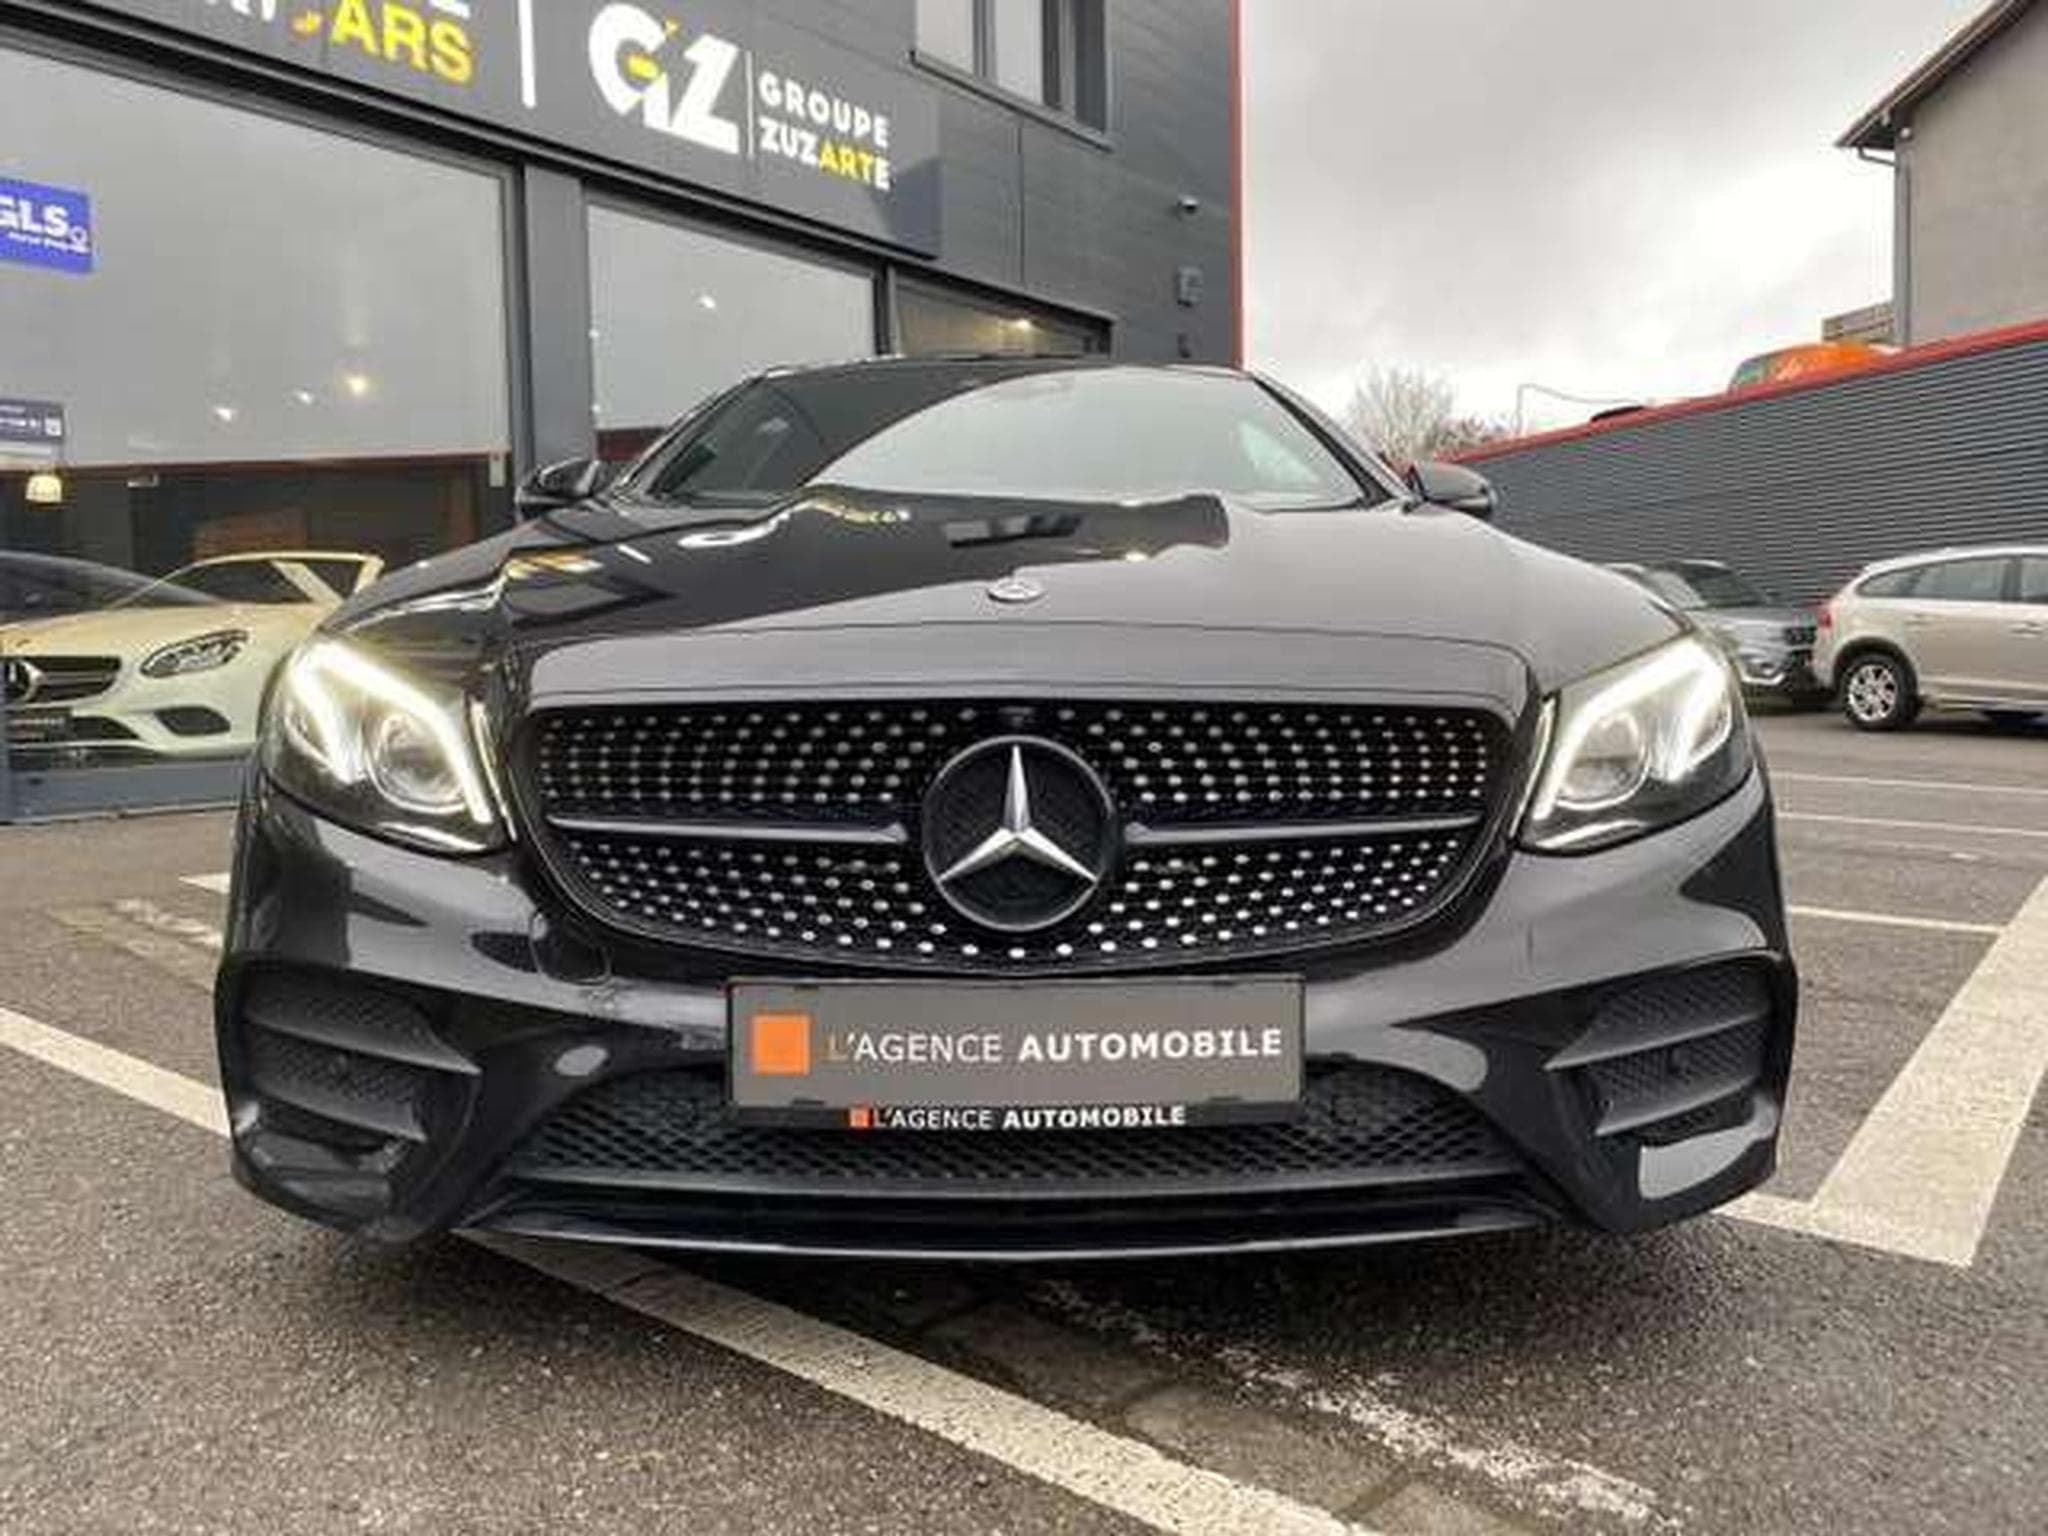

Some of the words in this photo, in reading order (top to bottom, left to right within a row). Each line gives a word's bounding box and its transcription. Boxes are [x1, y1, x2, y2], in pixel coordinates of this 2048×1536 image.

[758, 71, 890, 149] GROUPE
[758, 114, 891, 192] ZUZARTE
[1018, 1028, 1283, 1063] AUTOMOBILE
[1002, 1105, 1186, 1130] AUTOMOBILE
